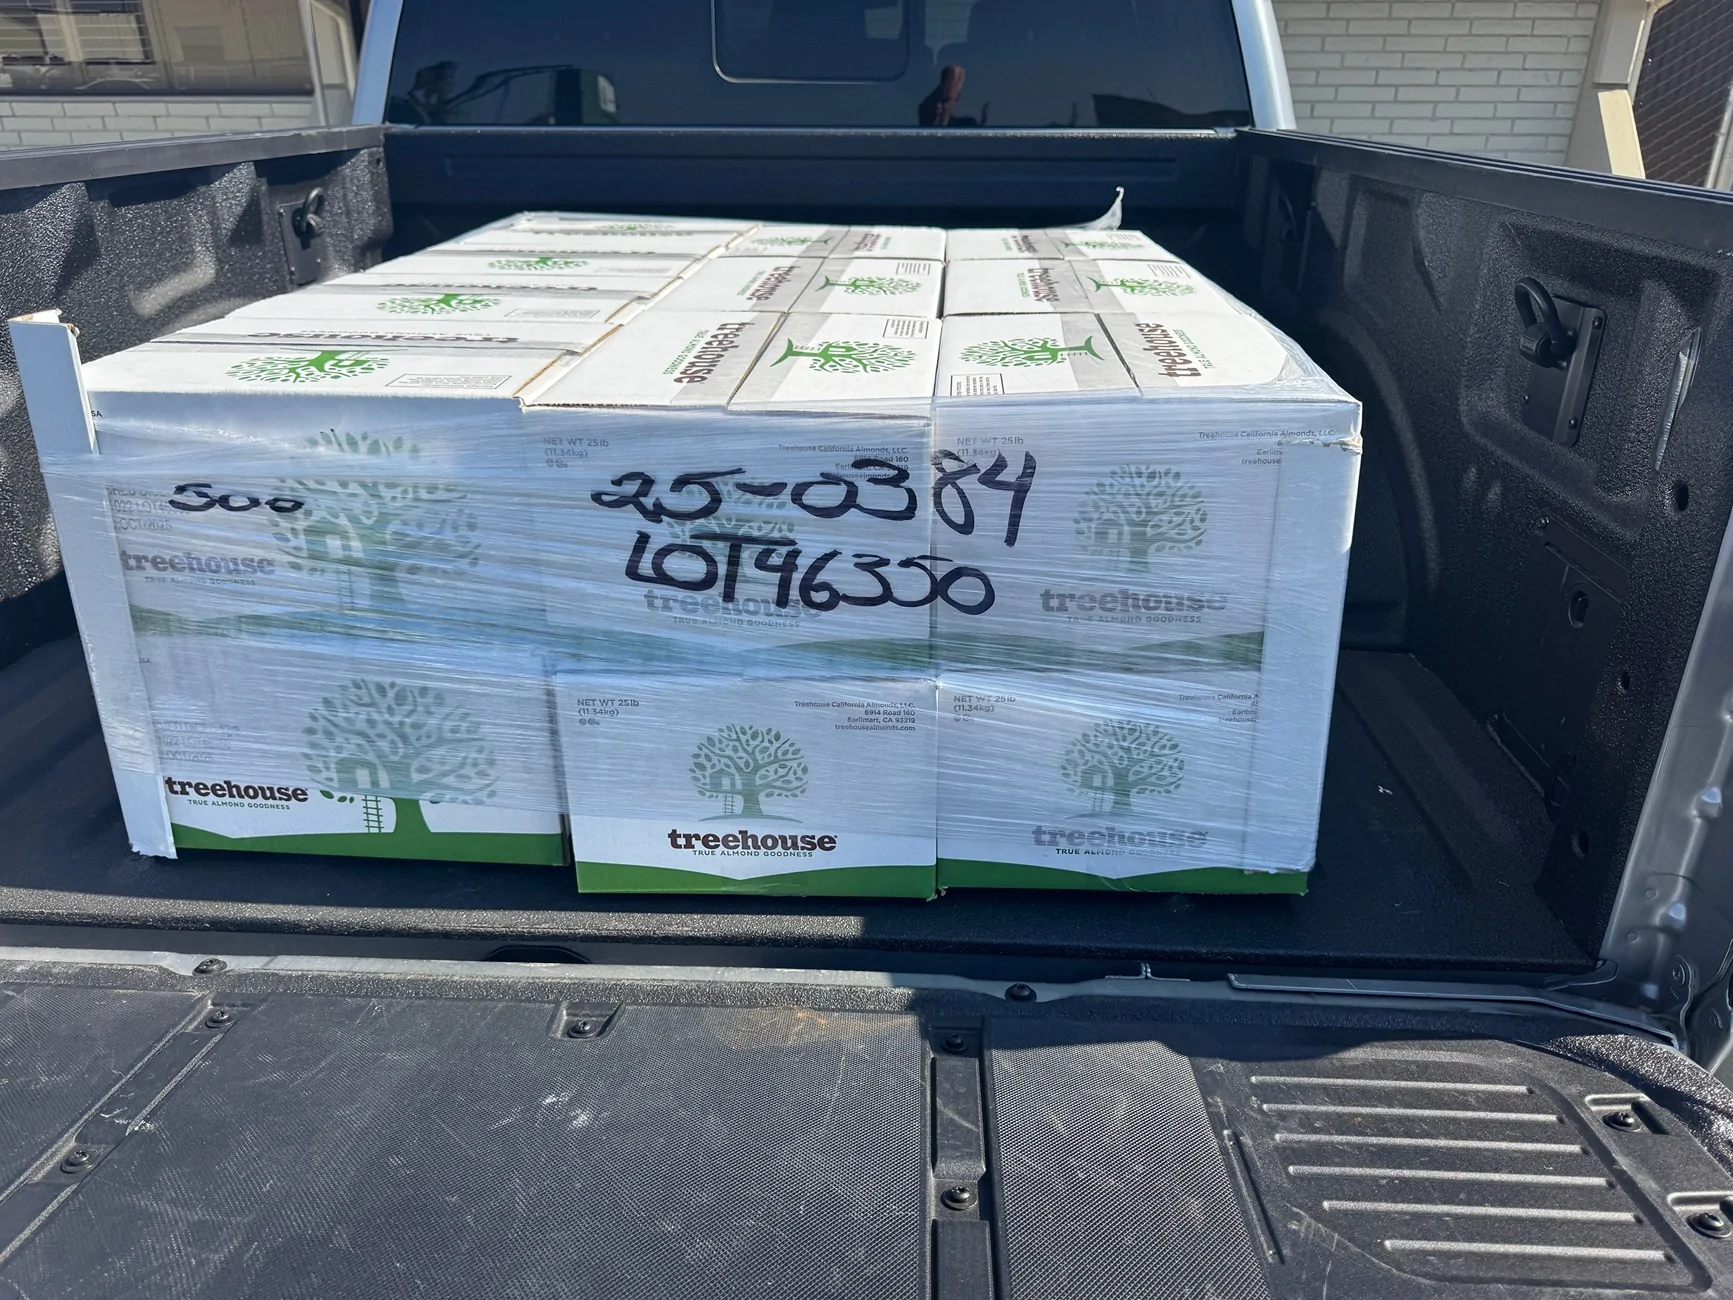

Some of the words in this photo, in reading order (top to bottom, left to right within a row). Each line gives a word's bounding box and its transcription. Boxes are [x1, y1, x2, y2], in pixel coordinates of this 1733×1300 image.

[673, 322, 755, 384] treehouse
[1134, 323, 1201, 377] treehouse
[1240, 430, 1278, 438] California
[1279, 429, 1317, 438] Almonds,
[1318, 428, 1336, 436] LLC.
[543, 437, 563, 446] NET
[567, 438, 583, 446] WT
[587, 437, 609, 447] 25lb
[957, 437, 977, 446] NET
[1001, 436, 1024, 444] 25lb
[778, 444, 816, 452] Treehouse
[817, 445, 854, 453] California
[855, 446, 891, 454] Almonds,
[168, 483, 304, 513] 500
[590, 449, 1036, 547] 25-0384
[120, 549, 276, 575] treehouse
[644, 589, 823, 618] treehouse
[1040, 588, 1228, 612] treehouse
[673, 616, 698, 625] TRUE
[747, 619, 800, 628] GOODNESS
[1067, 616, 1093, 624] TRUE
[1098, 615, 1142, 623] ALMOND
[1145, 615, 1202, 623] GOODNESS
[618, 699, 639, 707] 25lb
[794, 700, 830, 708] Treehouse
[953, 695, 973, 703] NET
[994, 695, 1016, 703] 25lb
[578, 708, 619, 717] (11.34kg)
[953, 704, 995, 713] (11.34kg)
[165, 776, 308, 802] treehouse
[187, 798, 208, 806] TRUE
[668, 829, 837, 852] treehouse
[1032, 825, 1207, 848] treehouse
[1084, 848, 1126, 856] ALMOND
